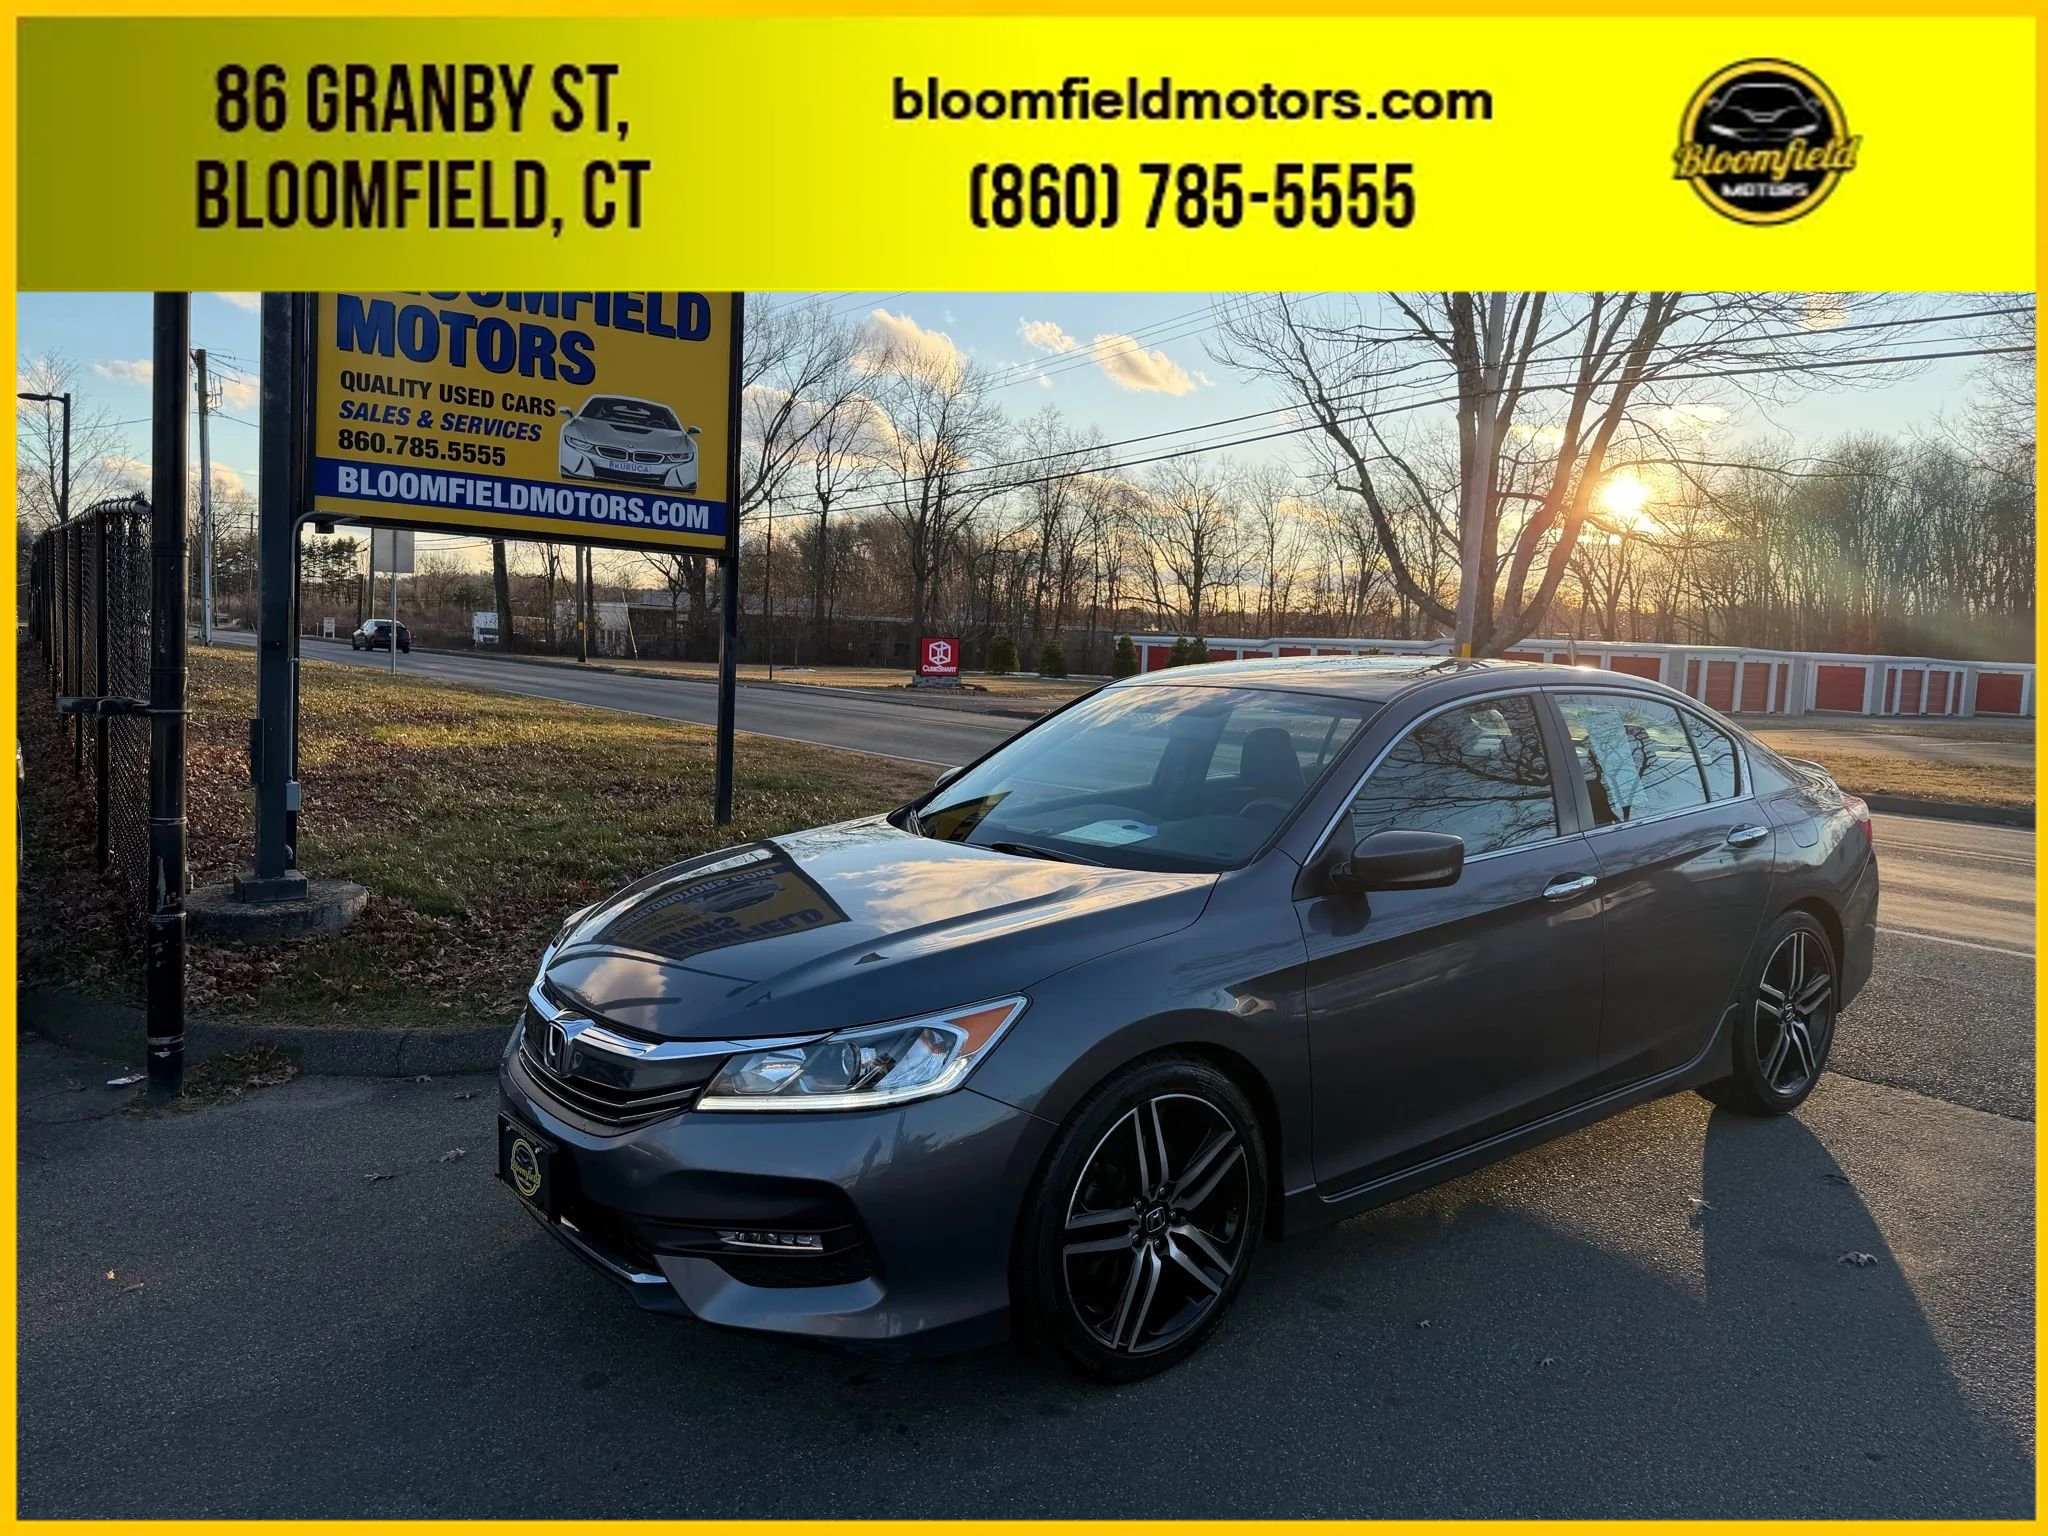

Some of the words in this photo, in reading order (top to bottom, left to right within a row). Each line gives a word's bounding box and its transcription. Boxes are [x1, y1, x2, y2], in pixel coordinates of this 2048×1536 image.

[336, 293, 597, 386] MOTORS
[340, 369, 433, 401] QUALITY
[439, 383, 495, 409] USED
[501, 392, 557, 418] CARS
[338, 399, 412, 427] SALES
[416, 409, 434, 429] &
[440, 412, 543, 442] SERVICES
[337, 428, 507, 467] 860.785.5555
[337, 465, 710, 530] BLOOMFIELDMOTORS.COM
